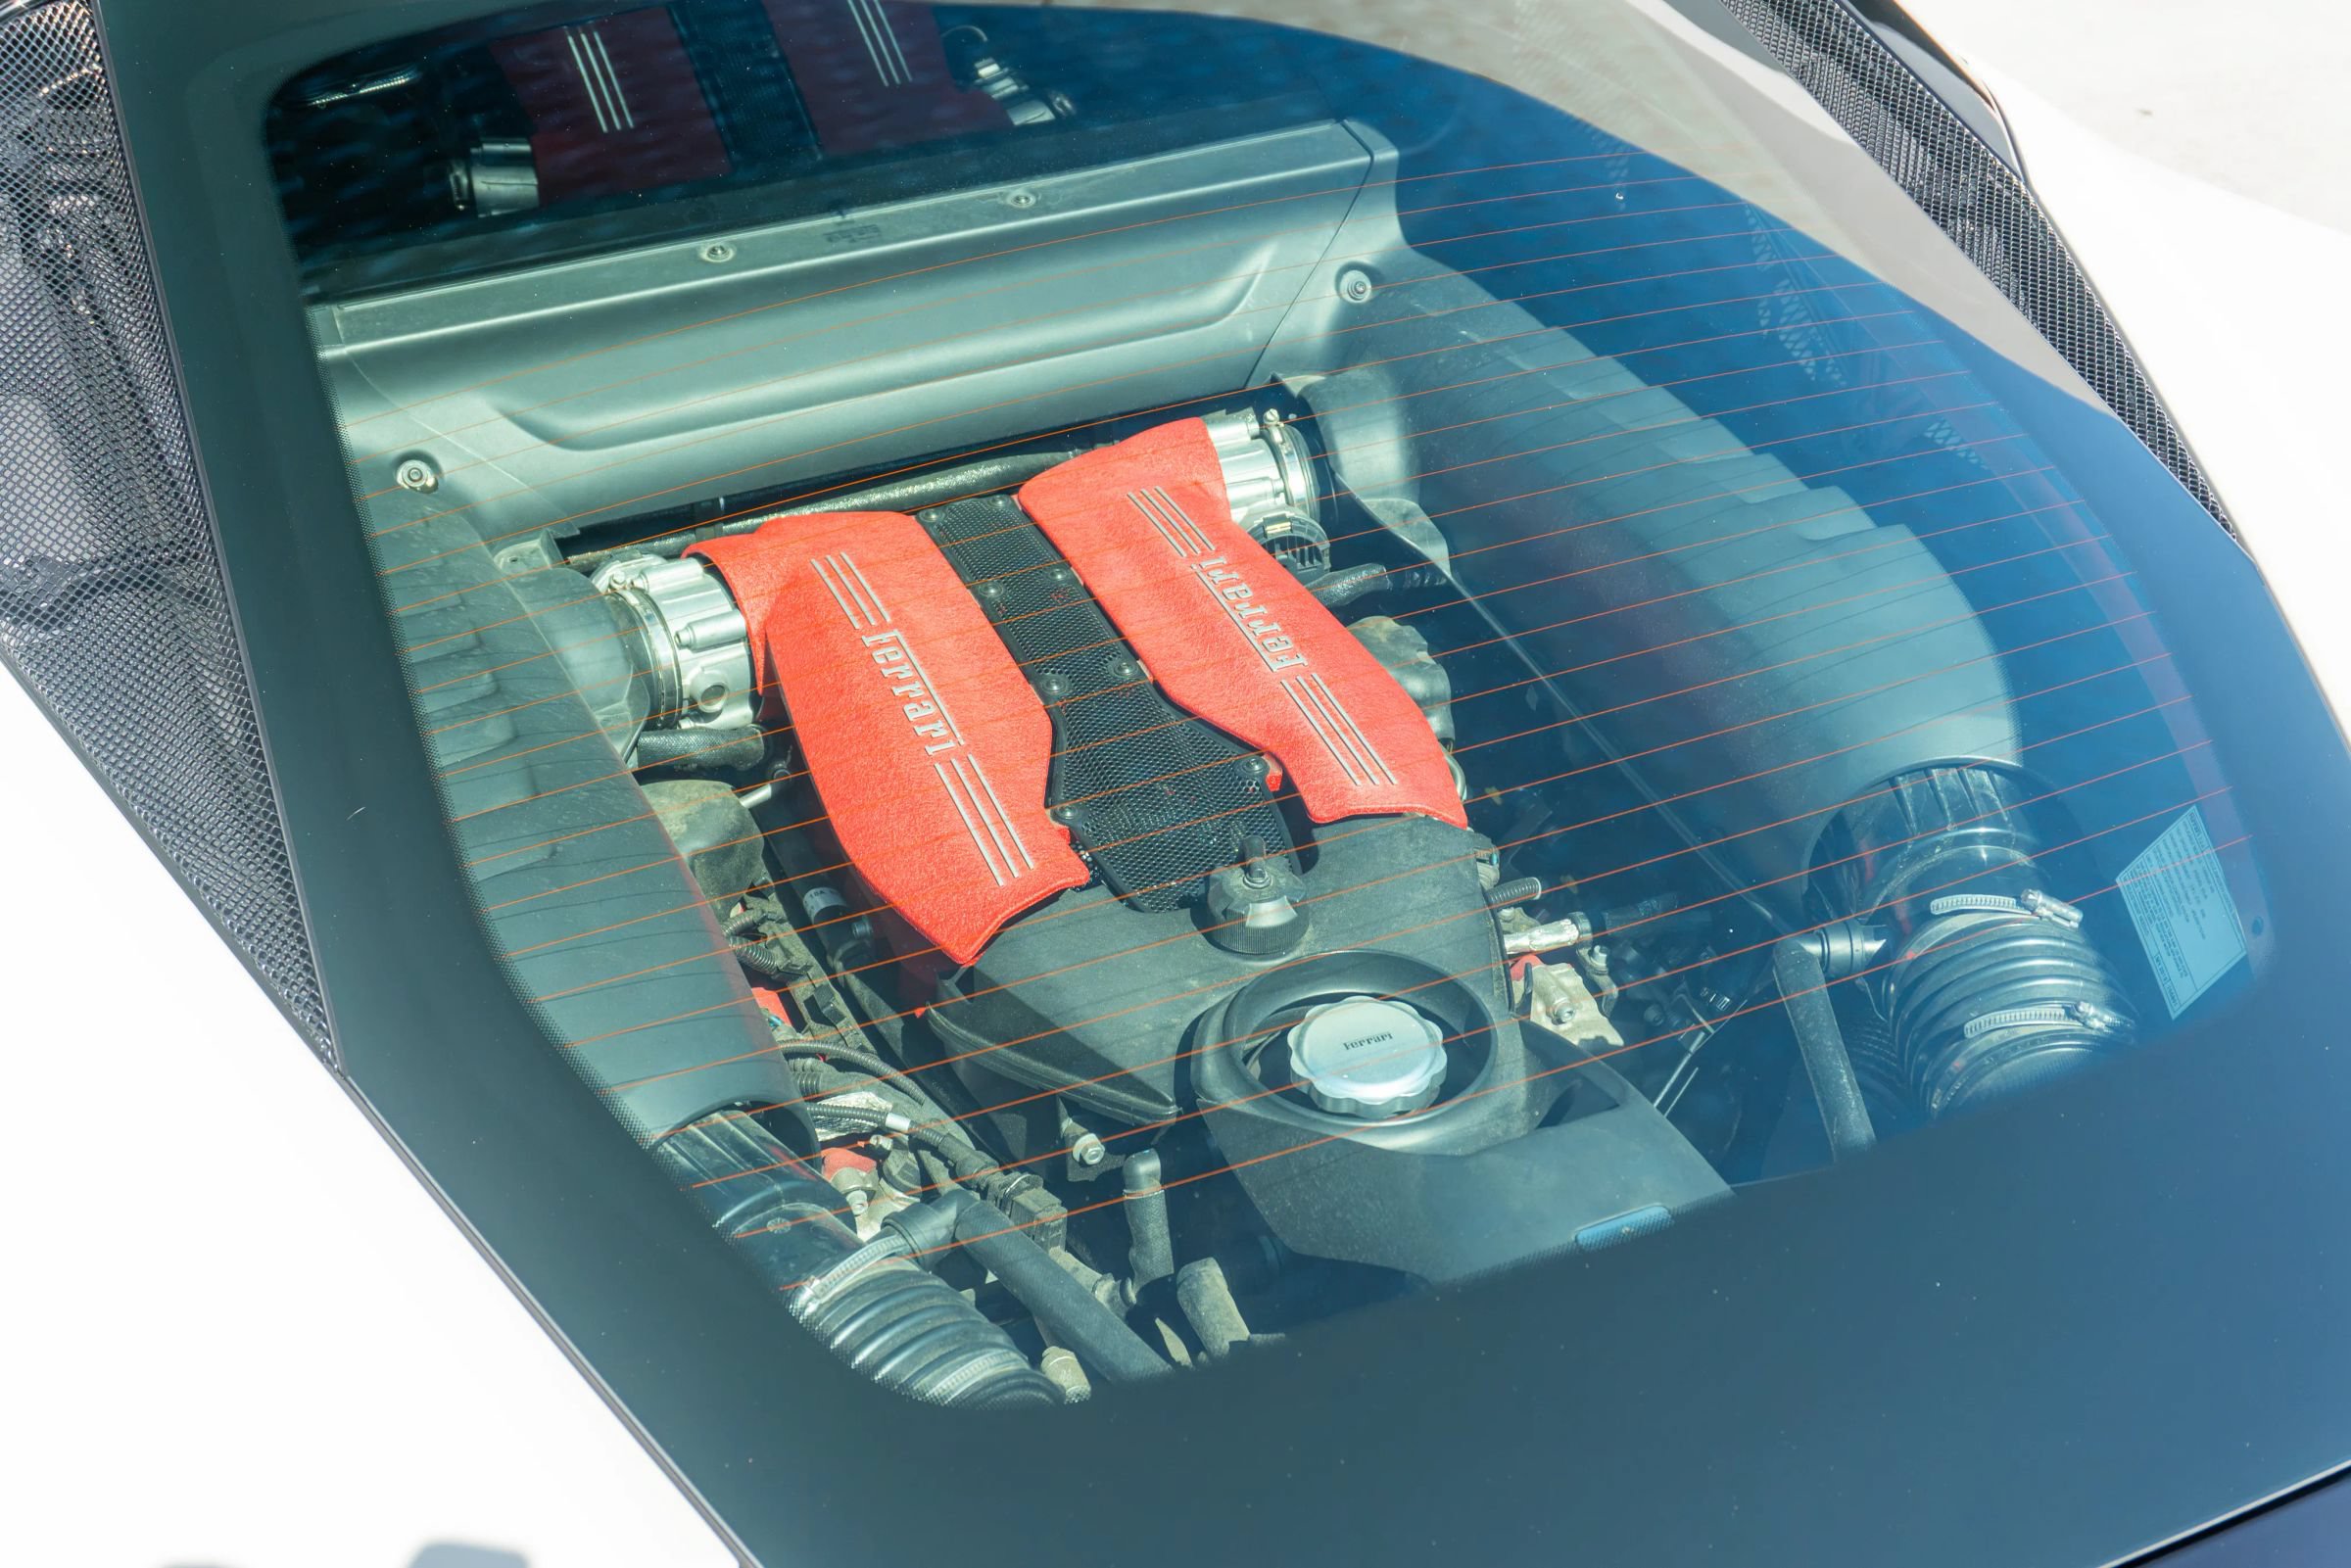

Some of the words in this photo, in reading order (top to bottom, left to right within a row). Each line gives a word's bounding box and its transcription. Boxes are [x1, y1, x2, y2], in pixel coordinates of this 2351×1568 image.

[1190, 555, 1309, 673] Ferrari
[861, 628, 965, 756] Ferrari
[1343, 1031, 1393, 1050] Ferrari
